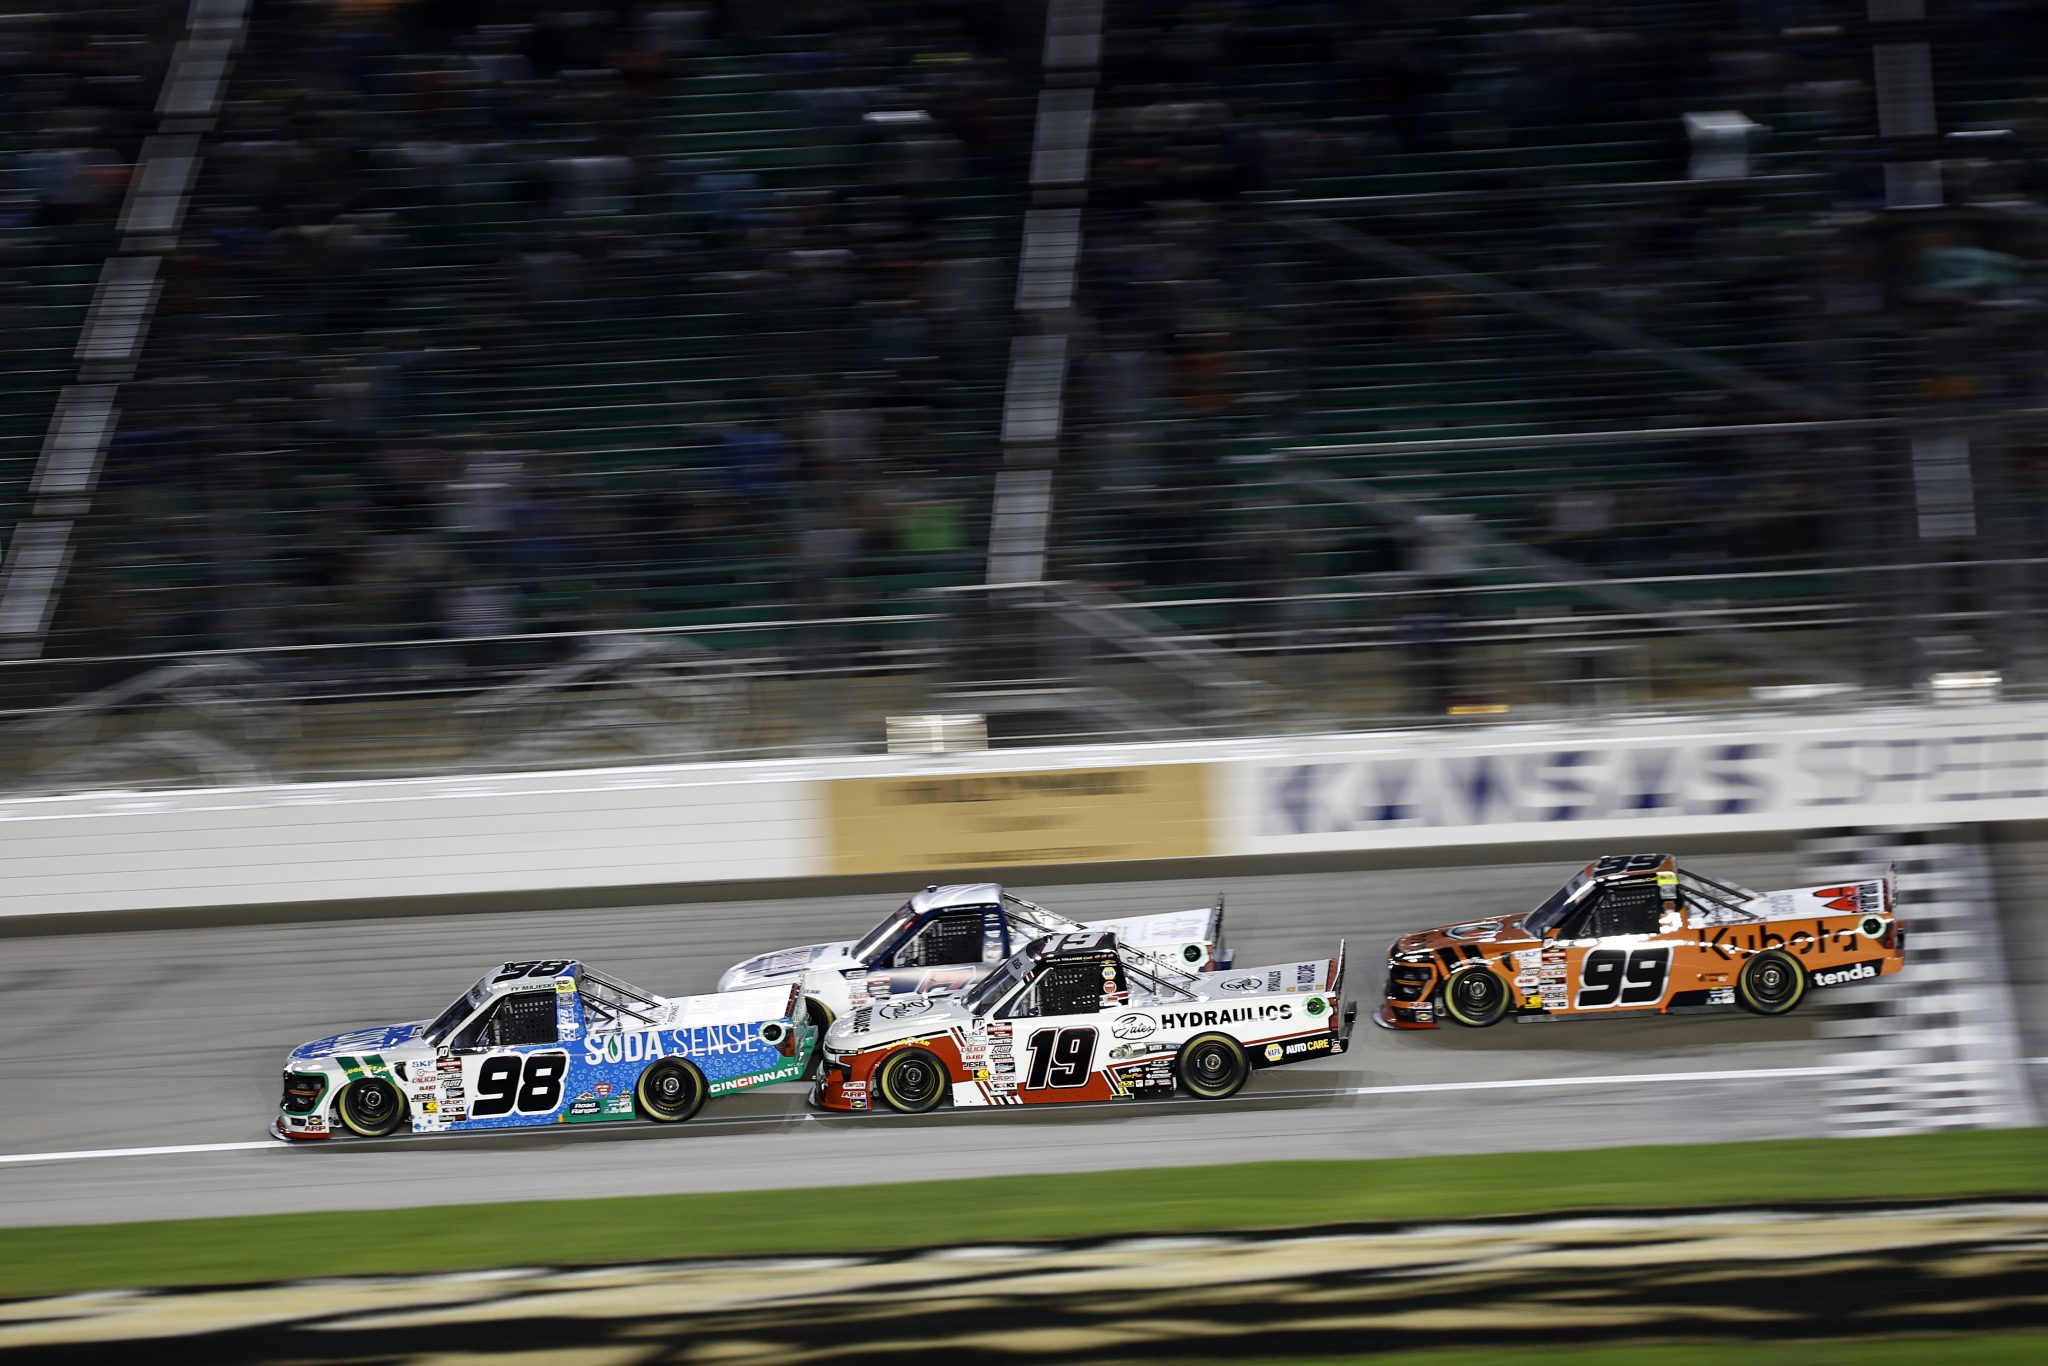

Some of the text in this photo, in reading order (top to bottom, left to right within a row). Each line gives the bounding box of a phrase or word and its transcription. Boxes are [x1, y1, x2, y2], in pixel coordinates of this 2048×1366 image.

[1041, 932, 1105, 954] 19
[1700, 920, 1858, 960] Kubota
[1577, 947, 1670, 1008] 99
[1814, 964, 1876, 986] tenda
[1113, 1015, 1156, 1039] Gates
[1161, 1004, 1293, 1030] HYDRAULICS
[583, 1020, 759, 1066] SODA SENSE
[1267, 1039, 1329, 1057] NAPA AUTO CARE
[412, 1060, 435, 1068] SKF
[1025, 1026, 1098, 1090] 19
[471, 1051, 566, 1117] 98
[709, 1066, 800, 1093] CINCINNATI
